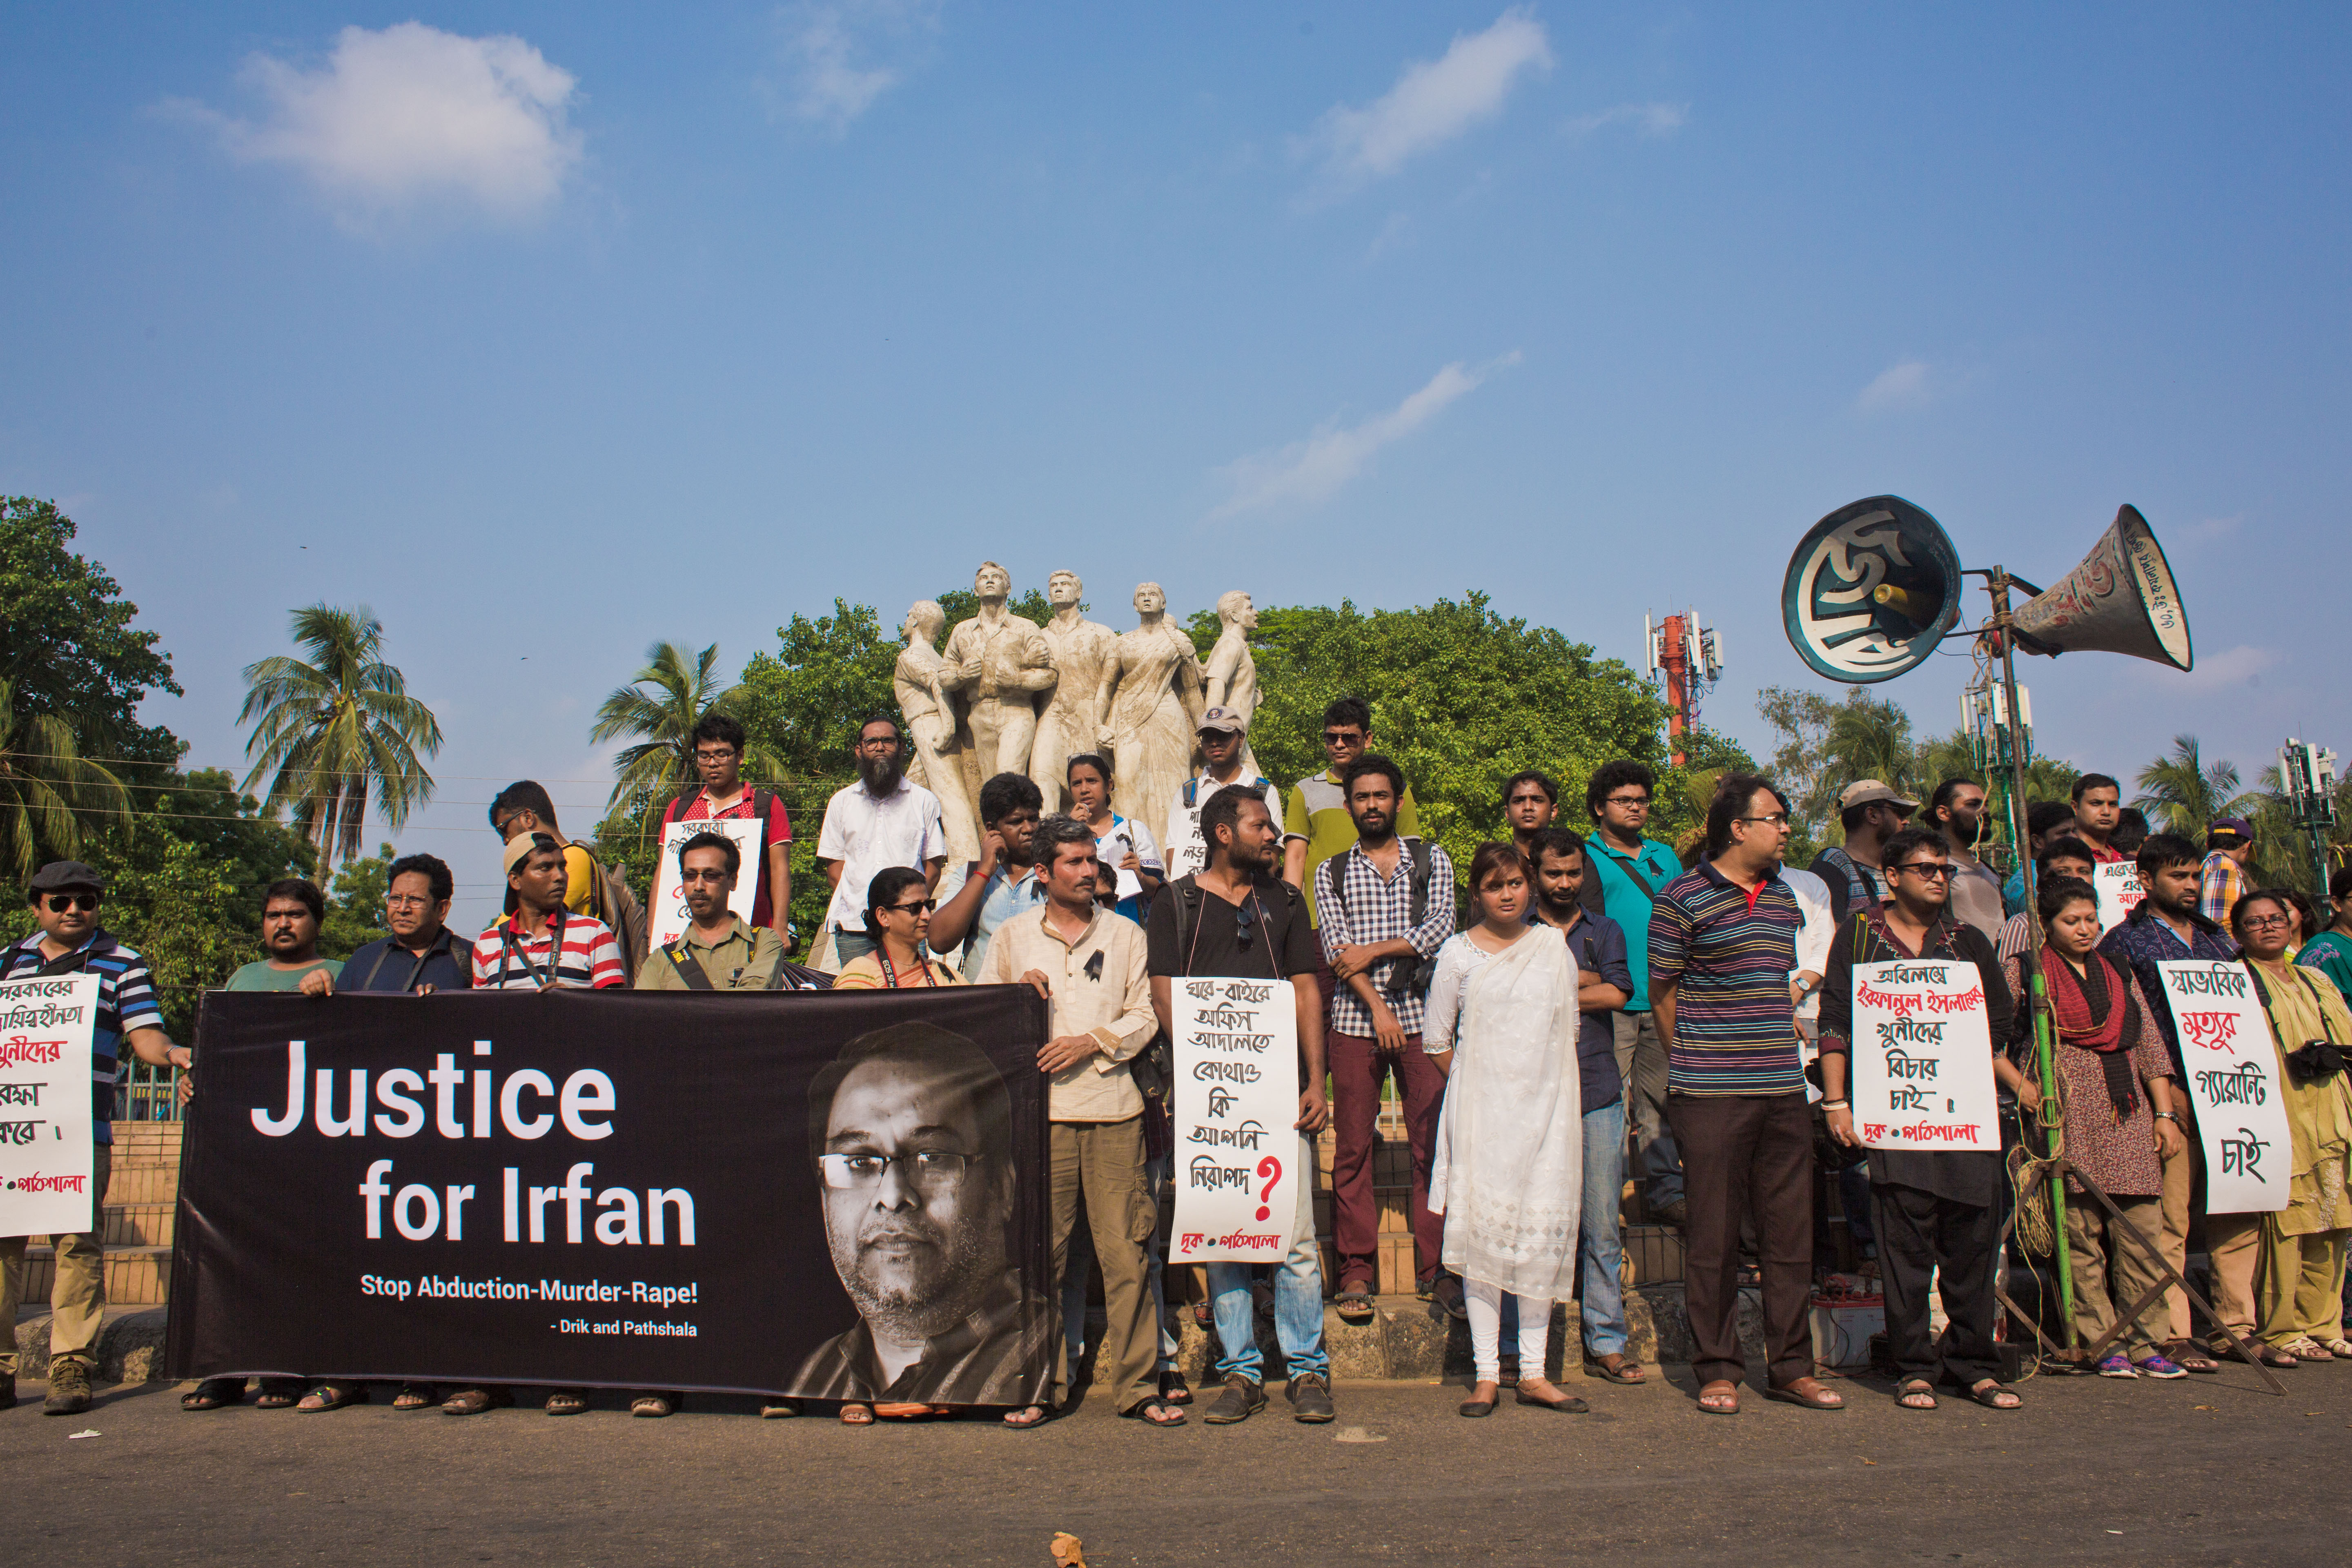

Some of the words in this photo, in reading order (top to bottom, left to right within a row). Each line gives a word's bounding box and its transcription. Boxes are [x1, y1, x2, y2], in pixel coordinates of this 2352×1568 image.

[882, 960, 892, 974] EOS
[1873, 964, 1949, 984] অবিলম্বে
[2168, 962, 2246, 999] স্বাভাবিক
[0, 981, 79, 1001] সরকারের
[1857, 980, 1923, 1017] ইরফানুল
[1927, 984, 1985, 1013] ইসলামের
[1194, 1001, 1259, 1031] অফিস
[1187, 1031, 1275, 1053] আদালতে
[1876, 1017, 1947, 1048] খুনীদের
[2181, 1011, 2241, 1054] মৃত্যুর
[1193, 1061, 1262, 1084] কোথাও
[1886, 1048, 1940, 1081] বিচার
[252, 1040, 615, 1140] Justice
[1207, 1087, 1239, 1118] কি
[1890, 1085, 1937, 1111] চাই
[1186, 1120, 1269, 1151] আপনি
[1864, 1123, 1887, 1144] দৃক
[1902, 1120, 1981, 1144] পাঠশালা
[2221, 1127, 2270, 1184] চাই
[18, 1171, 87, 1194] পাঠশালা
[1190, 1155, 1250, 1195] নিরাপদ
[360, 1160, 474, 1241] for
[505, 1162, 696, 1246] Irfan
[1180, 1233, 1205, 1254] দৃক
[1219, 1228, 1281, 1250] পাঠশালা
[361, 1274, 411, 1301] Stop
[418, 1275, 697, 1308] Abduction-Murder-Rape!
[560, 1319, 589, 1334] Drik
[593, 1320, 619, 1334] and
[624, 1320, 697, 1337] Pathshala
